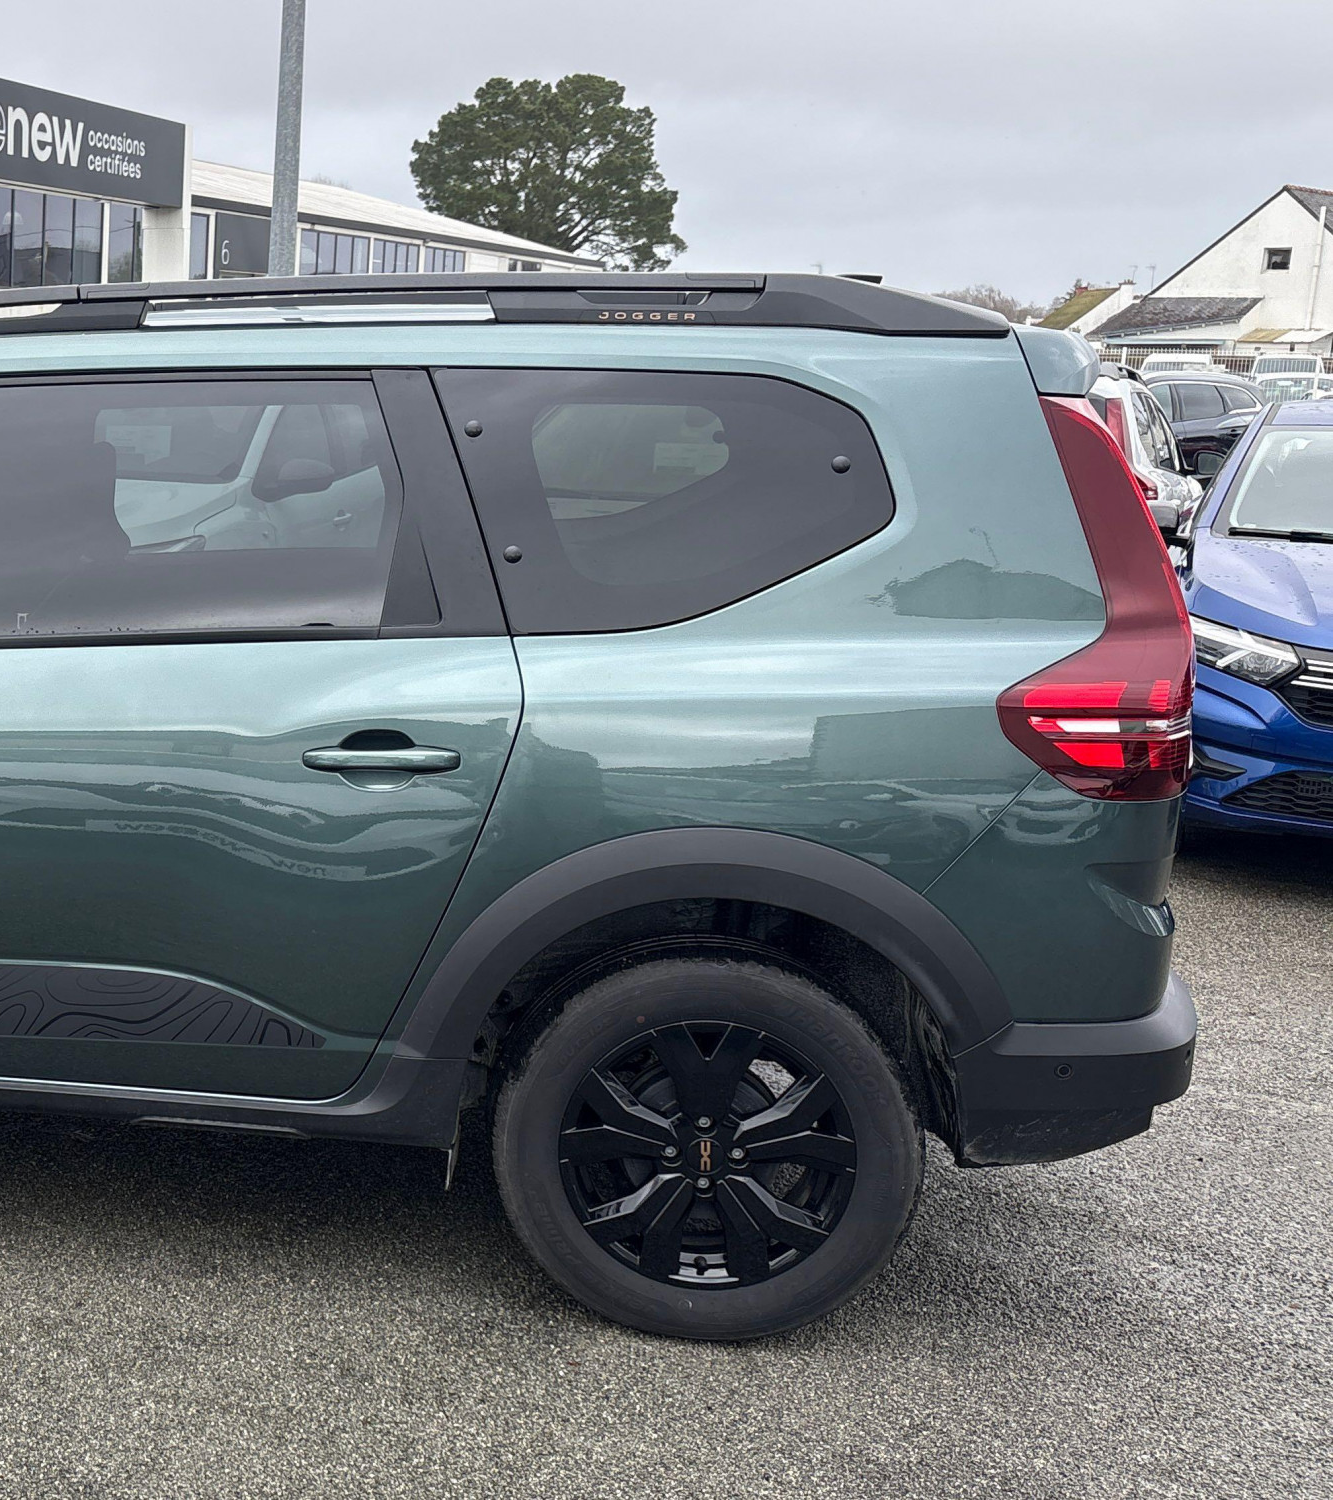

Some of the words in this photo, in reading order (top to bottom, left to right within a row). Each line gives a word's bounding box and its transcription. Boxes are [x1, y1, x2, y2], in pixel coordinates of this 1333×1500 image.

[88, 130, 146, 157] occasions
[87, 153, 142, 179] certifiées
[221, 239, 230, 265] 6
[598, 305, 697, 320] JOGGER
